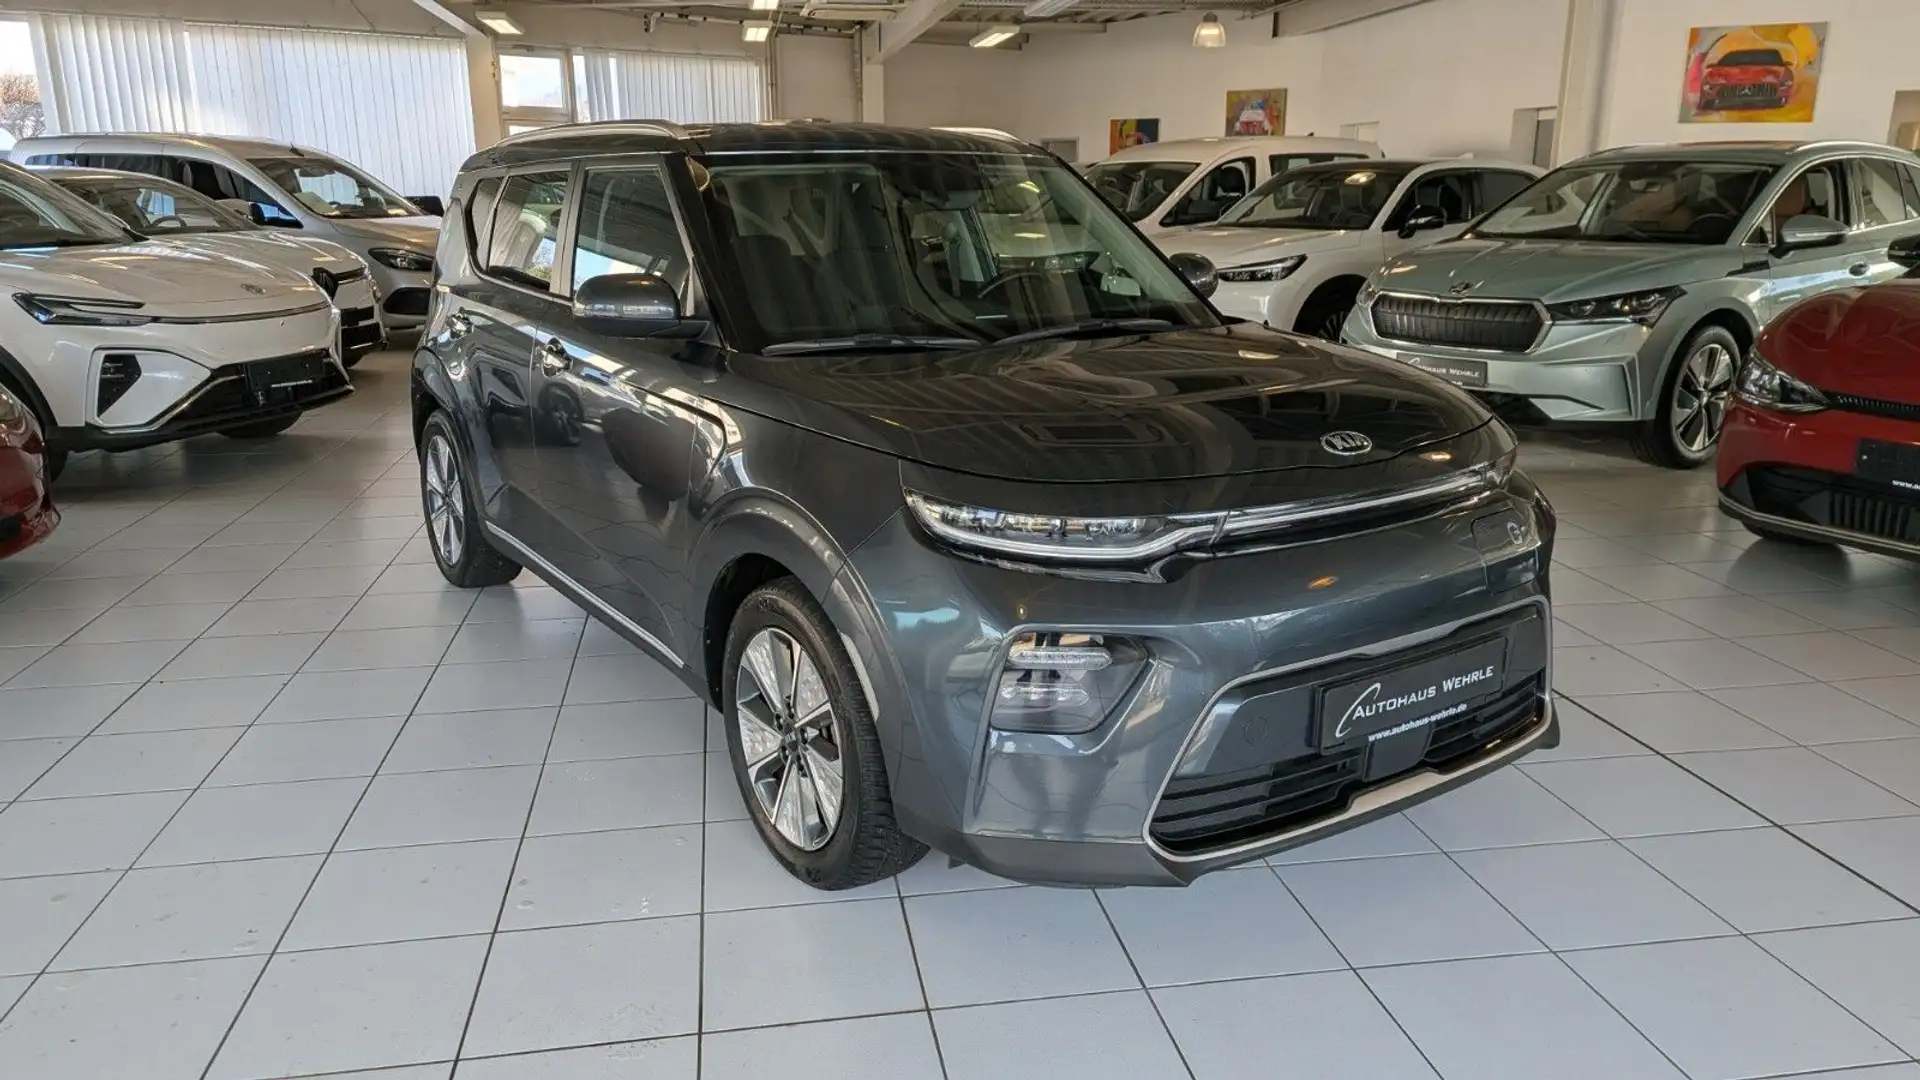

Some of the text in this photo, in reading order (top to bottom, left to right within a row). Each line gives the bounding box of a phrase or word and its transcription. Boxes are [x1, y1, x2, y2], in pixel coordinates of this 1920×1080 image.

[1450, 368, 1480, 378] WEHRLE
[1326, 433, 1370, 451] KIA
[1352, 665, 1494, 721] AUTOHAUS WEHRLE
[1367, 703, 1468, 742] www.autohaus-wehrle.de
